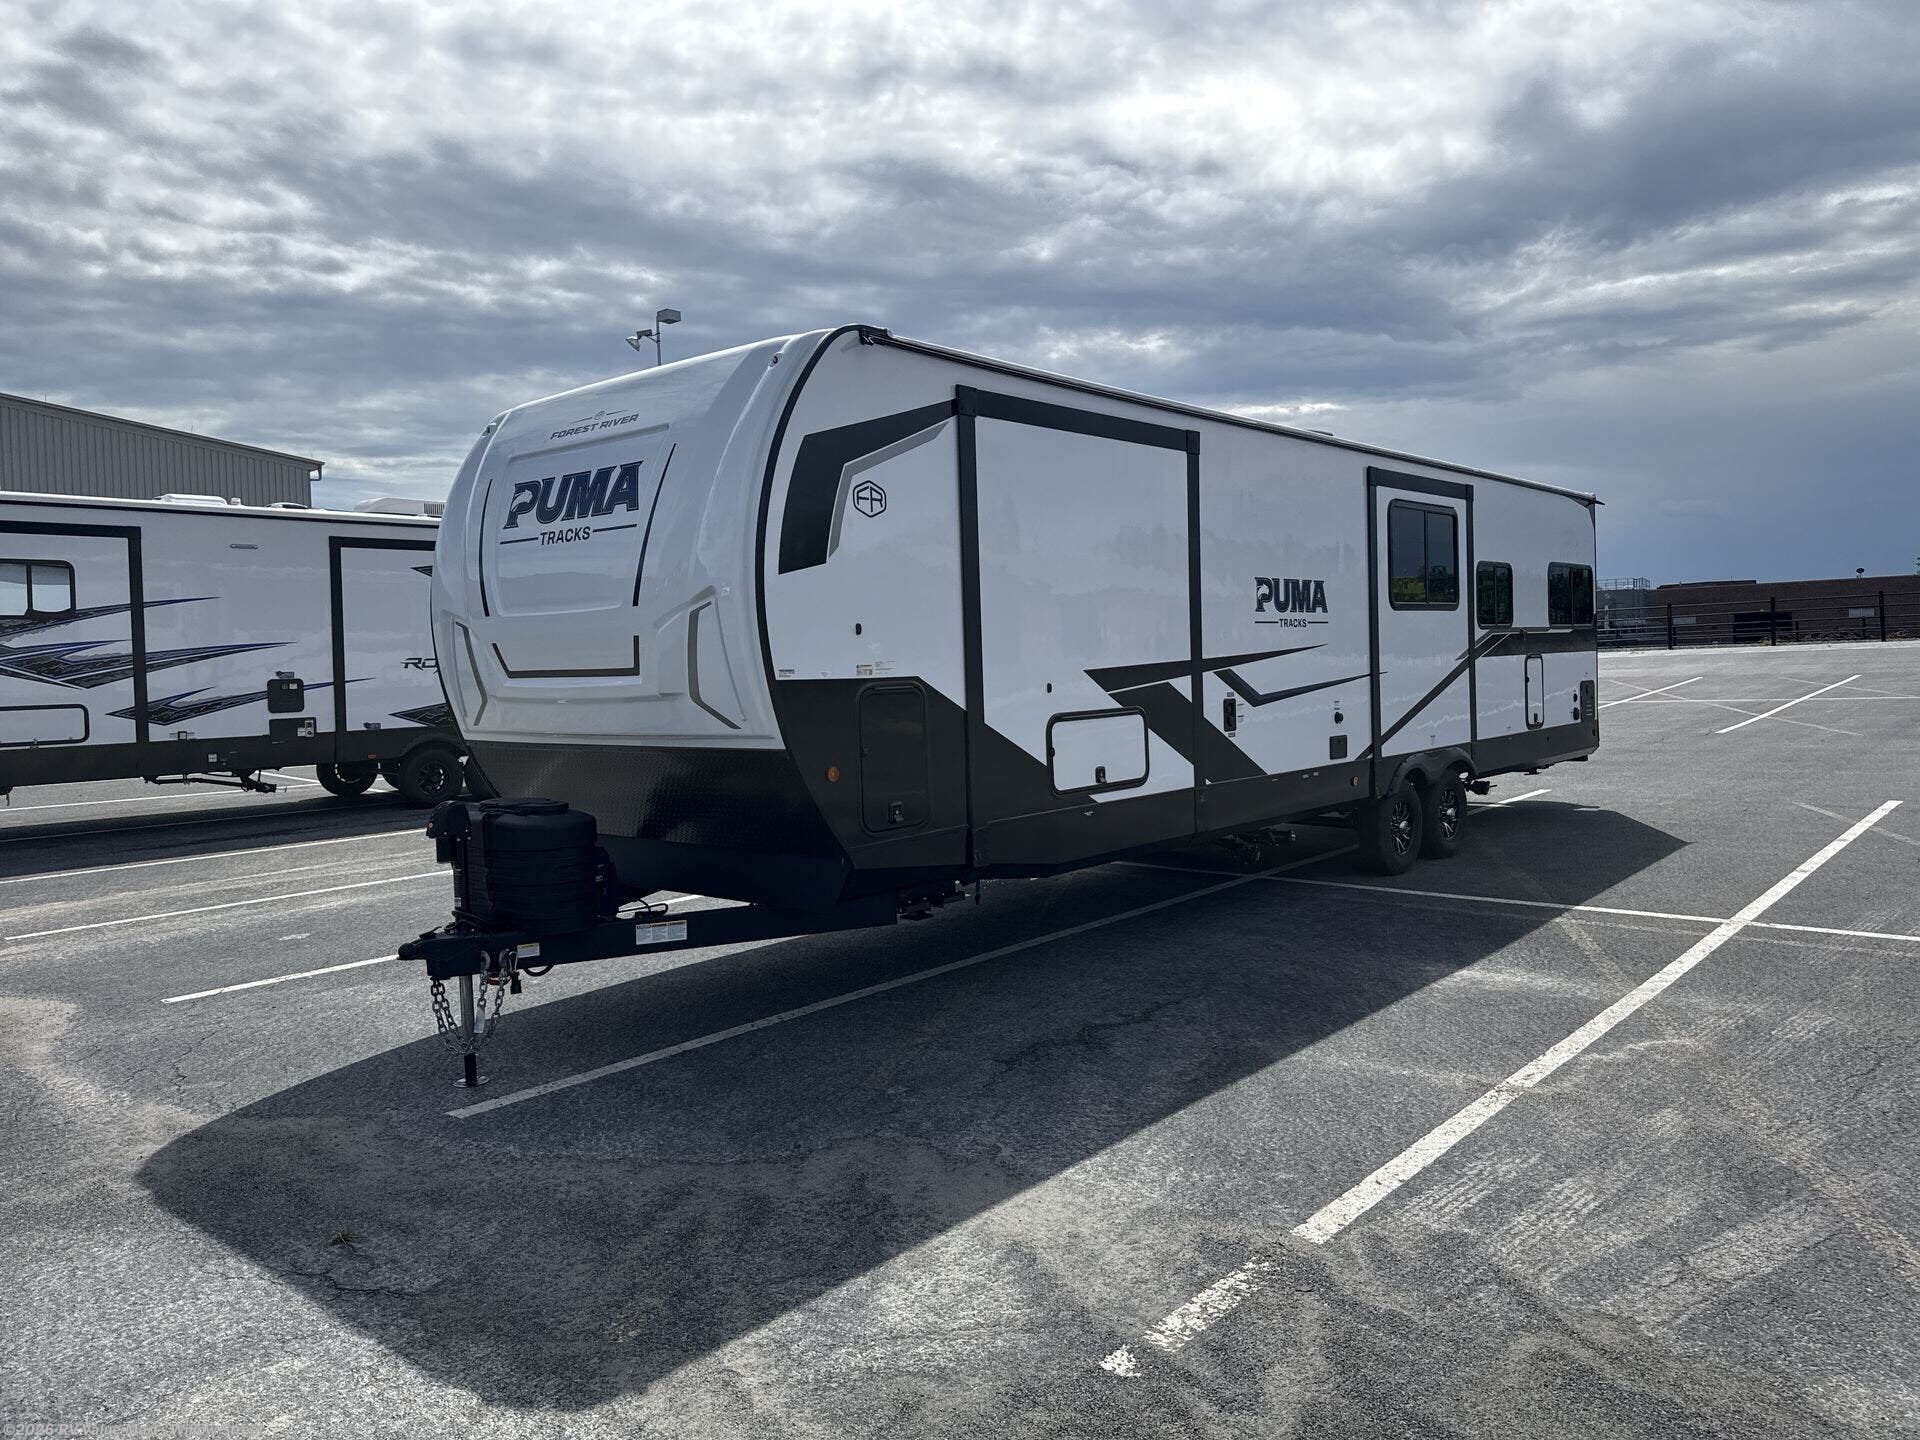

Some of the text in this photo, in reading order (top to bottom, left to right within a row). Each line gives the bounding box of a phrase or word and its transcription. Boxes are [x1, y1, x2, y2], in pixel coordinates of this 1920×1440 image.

[550, 413, 640, 440] FOREST RIVER
[502, 460, 644, 530] PUMA
[540, 526, 591, 546] TRACKS
[1254, 576, 1328, 613] PUMA
[1279, 618, 1307, 628] TRACKS
